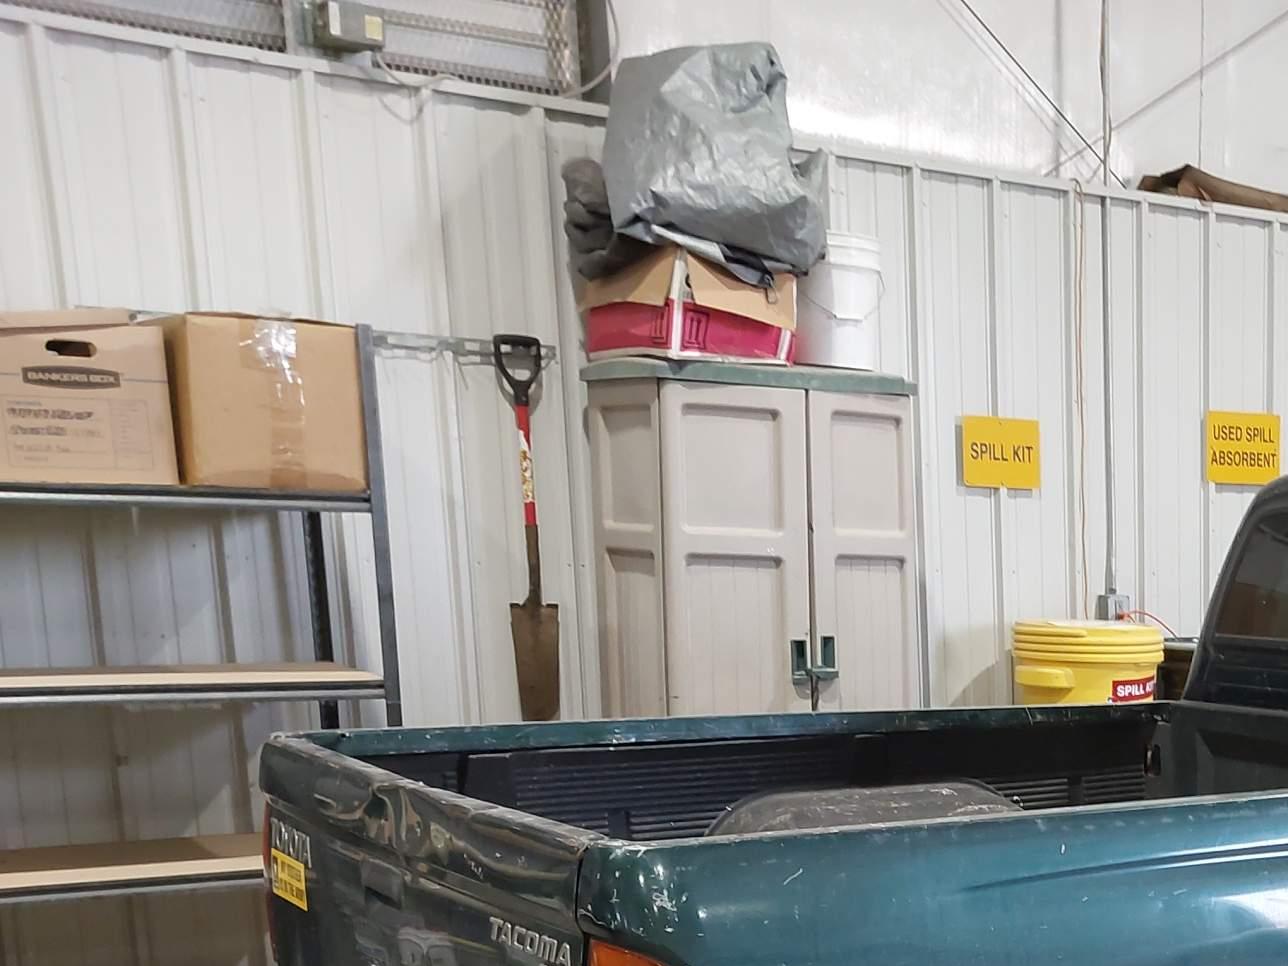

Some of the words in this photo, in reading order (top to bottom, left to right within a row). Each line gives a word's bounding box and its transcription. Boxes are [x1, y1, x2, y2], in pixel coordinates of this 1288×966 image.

[27, 371, 88, 382] BANKERS
[89, 374, 116, 383] BOX
[1213, 424, 1242, 442] USED
[1245, 425, 1274, 443] SPILL
[970, 442, 1008, 462] SPILL
[1013, 445, 1033, 463] KIT
[1210, 449, 1276, 468] ABSORBENT
[1116, 684, 1145, 697] SPILL
